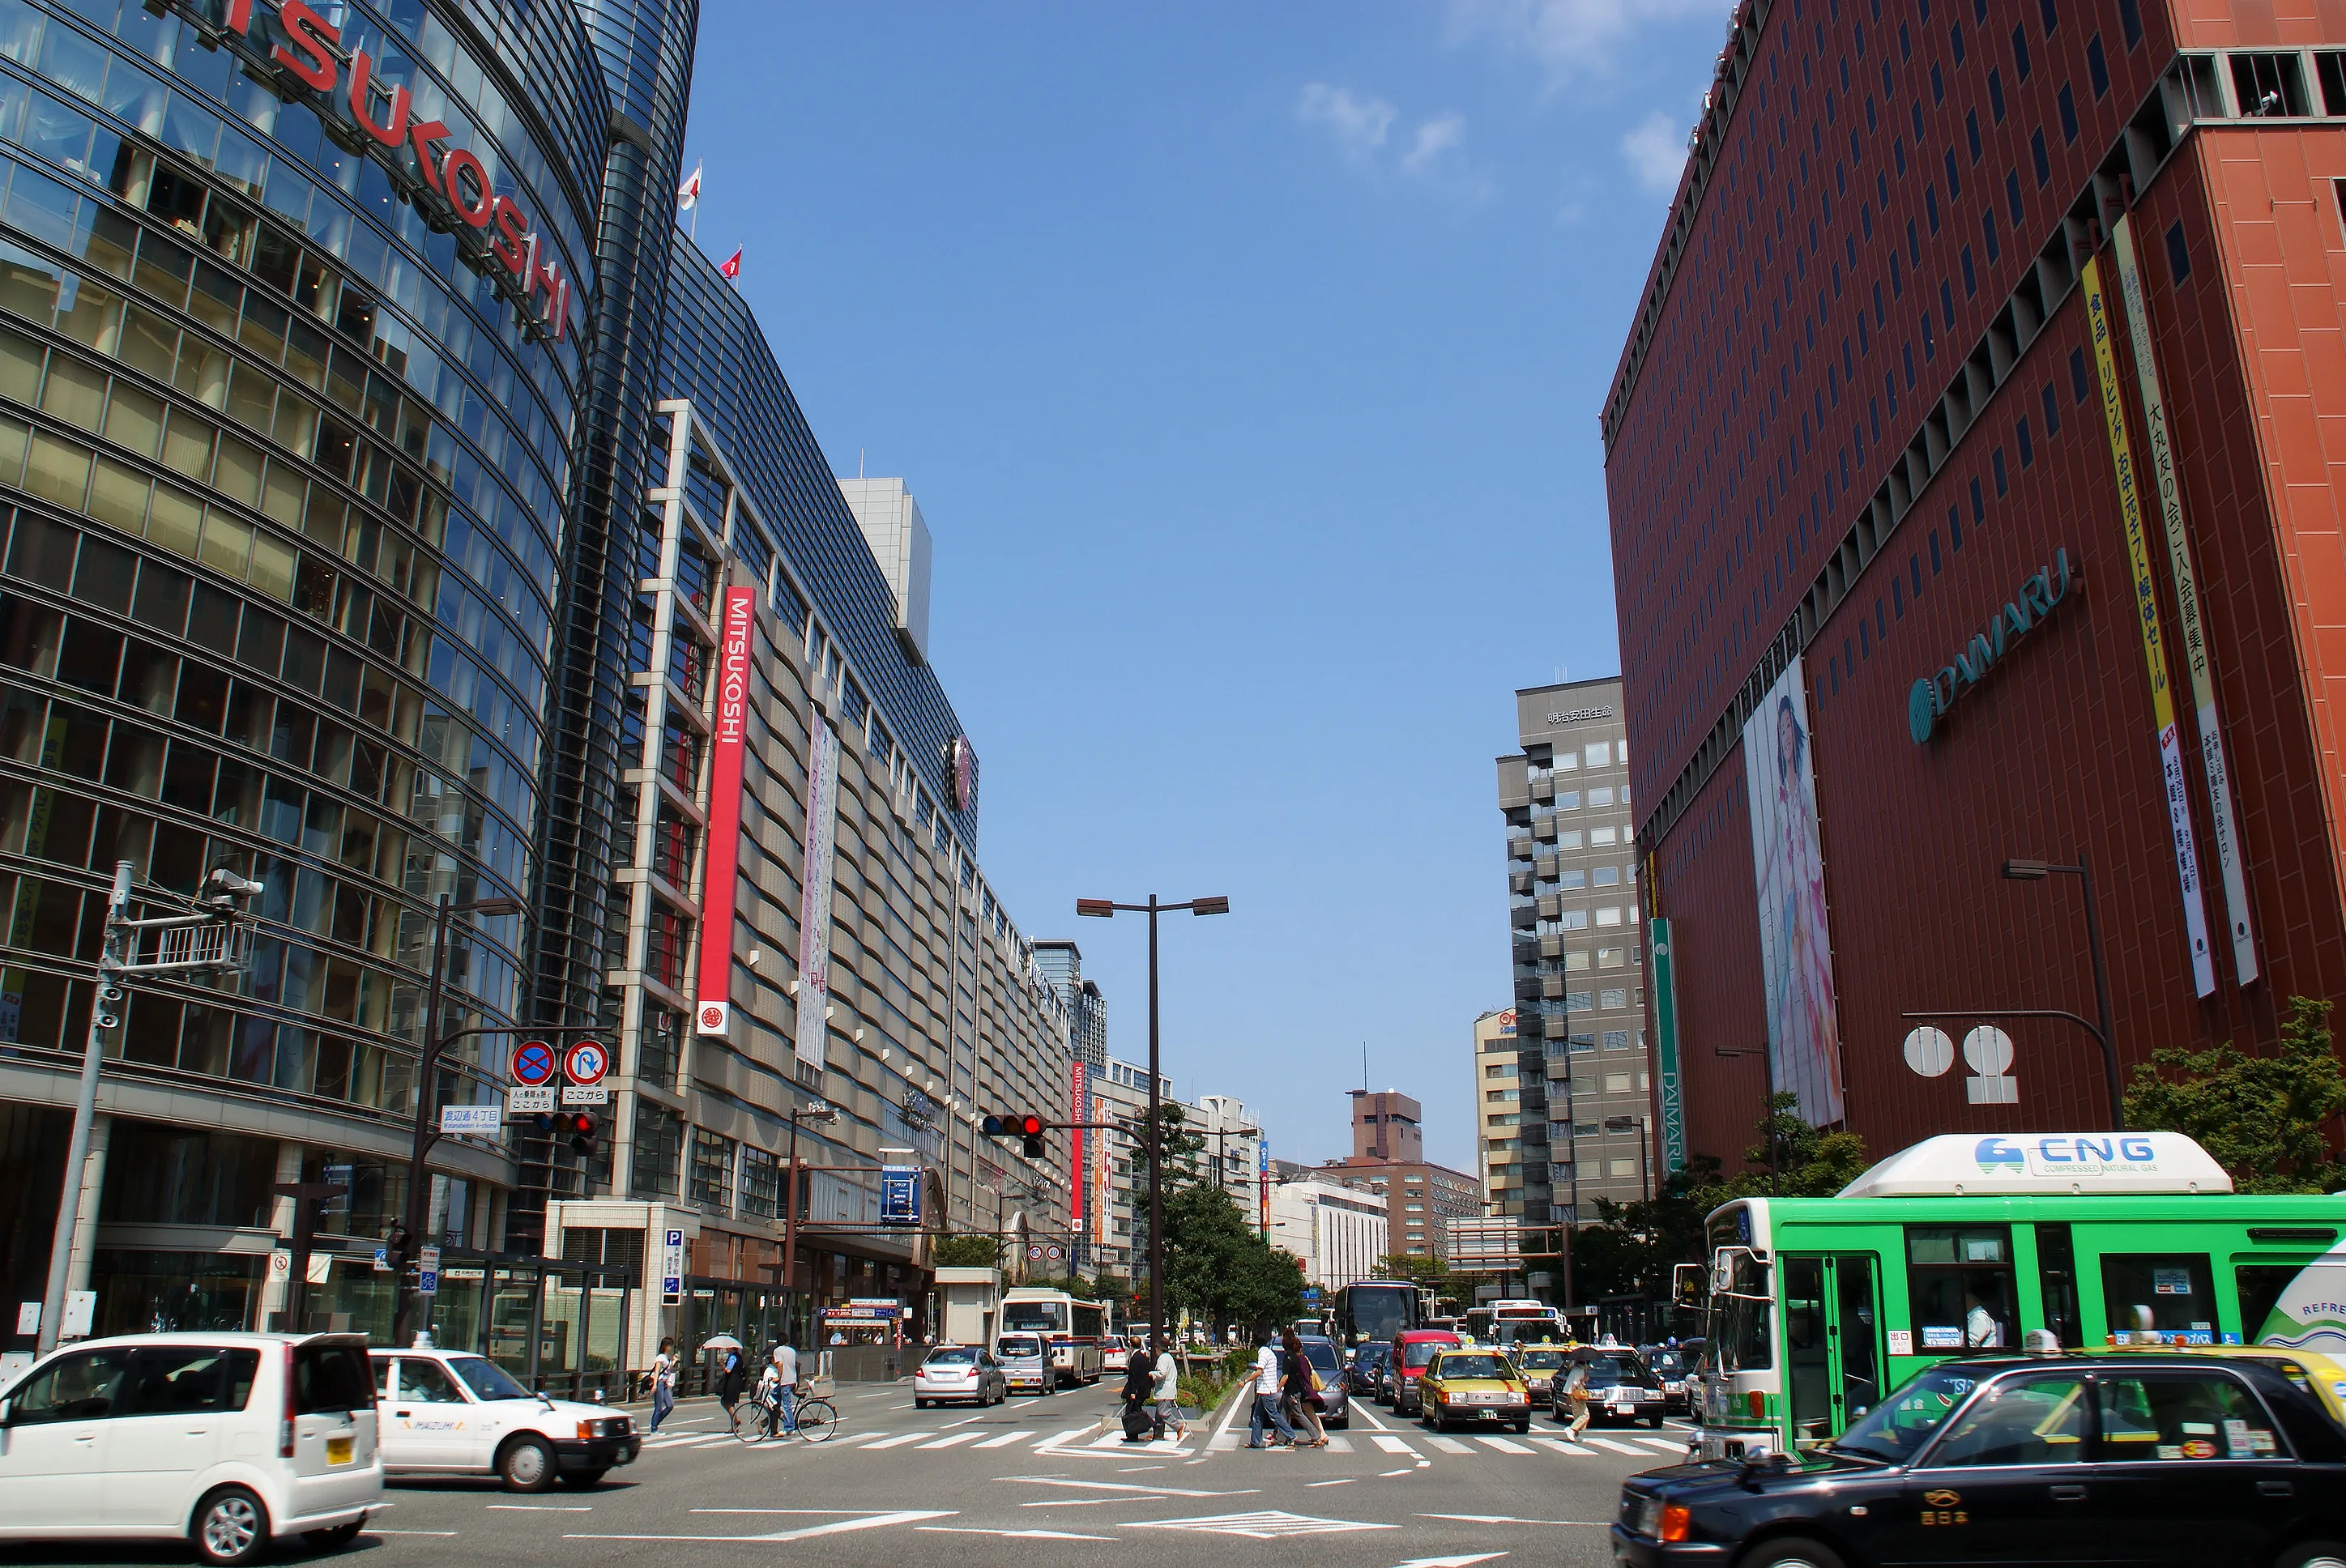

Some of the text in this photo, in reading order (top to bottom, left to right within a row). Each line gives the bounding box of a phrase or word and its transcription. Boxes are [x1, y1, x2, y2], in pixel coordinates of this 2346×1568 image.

[2089, 293, 2165, 693] 食品・リビング お中元ギフト解体セール
[2148, 403, 2206, 678] 大丸友の会ご入会募集中
[1934, 548, 2071, 716] DAIMARU
[722, 598, 749, 744] MITSUKOSHI
[1547, 705, 1612, 724] 明治安田生命
[566, 1091, 604, 1100] ここから
[514, 1101, 551, 1109] ここから
[1663, 1072, 1682, 1172] DAIMARU
[2039, 1138, 2154, 1162] CNG
[2044, 1164, 2158, 1174] COMPRESSED NATURAL GAS
[670, 1231, 680, 1245] P
[821, 1308, 826, 1316] P
[1890, 1332, 1909, 1340] 出口
[1919, 1511, 1969, 1525] 西日本
